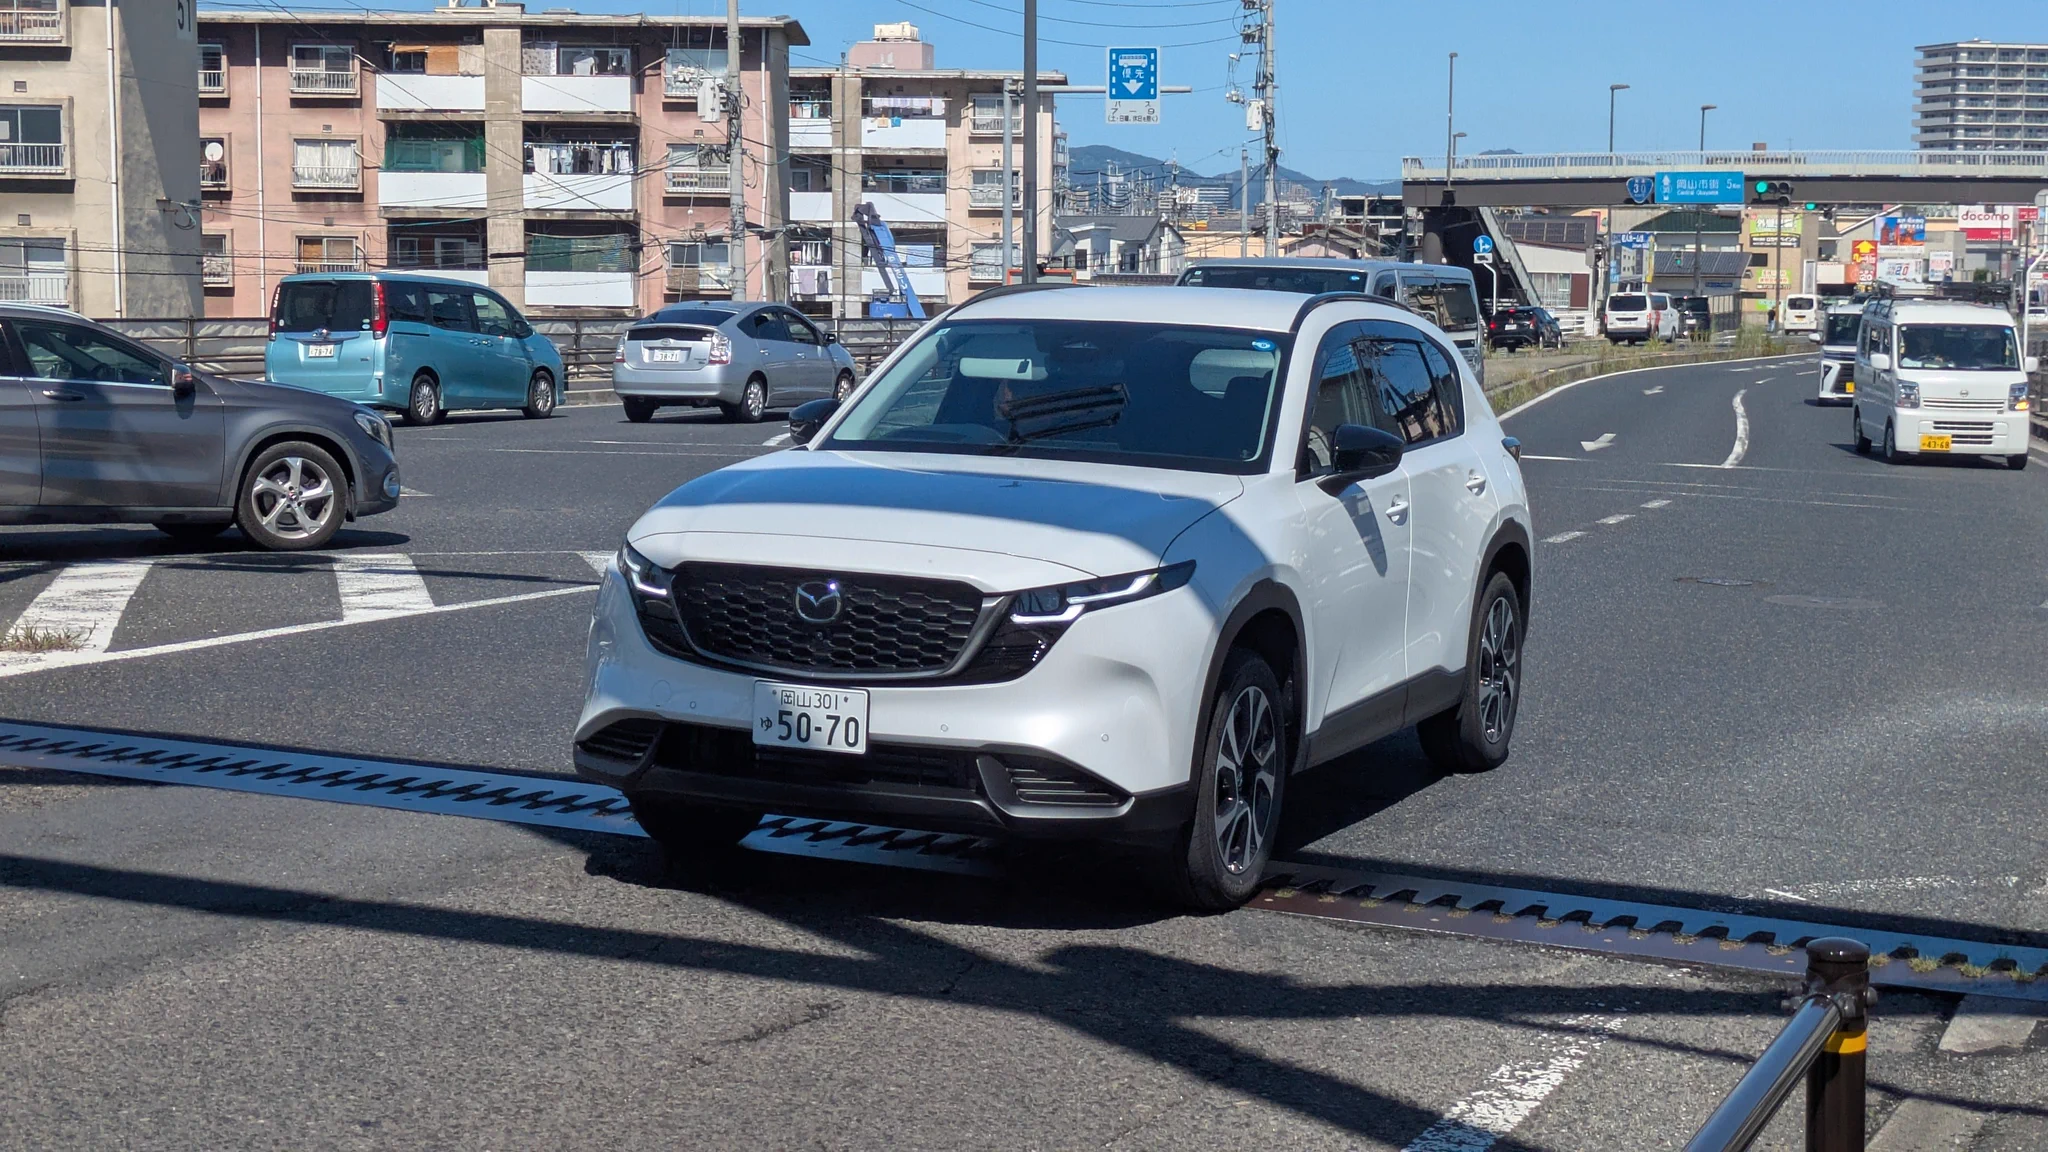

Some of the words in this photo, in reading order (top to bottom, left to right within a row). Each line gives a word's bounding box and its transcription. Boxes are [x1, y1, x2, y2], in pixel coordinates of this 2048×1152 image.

[1122, 68, 1145, 79] 優先
[1633, 184, 1646, 194] 30
[1961, 210, 2010, 221] docomo
[777, 709, 860, 748] 50-70
